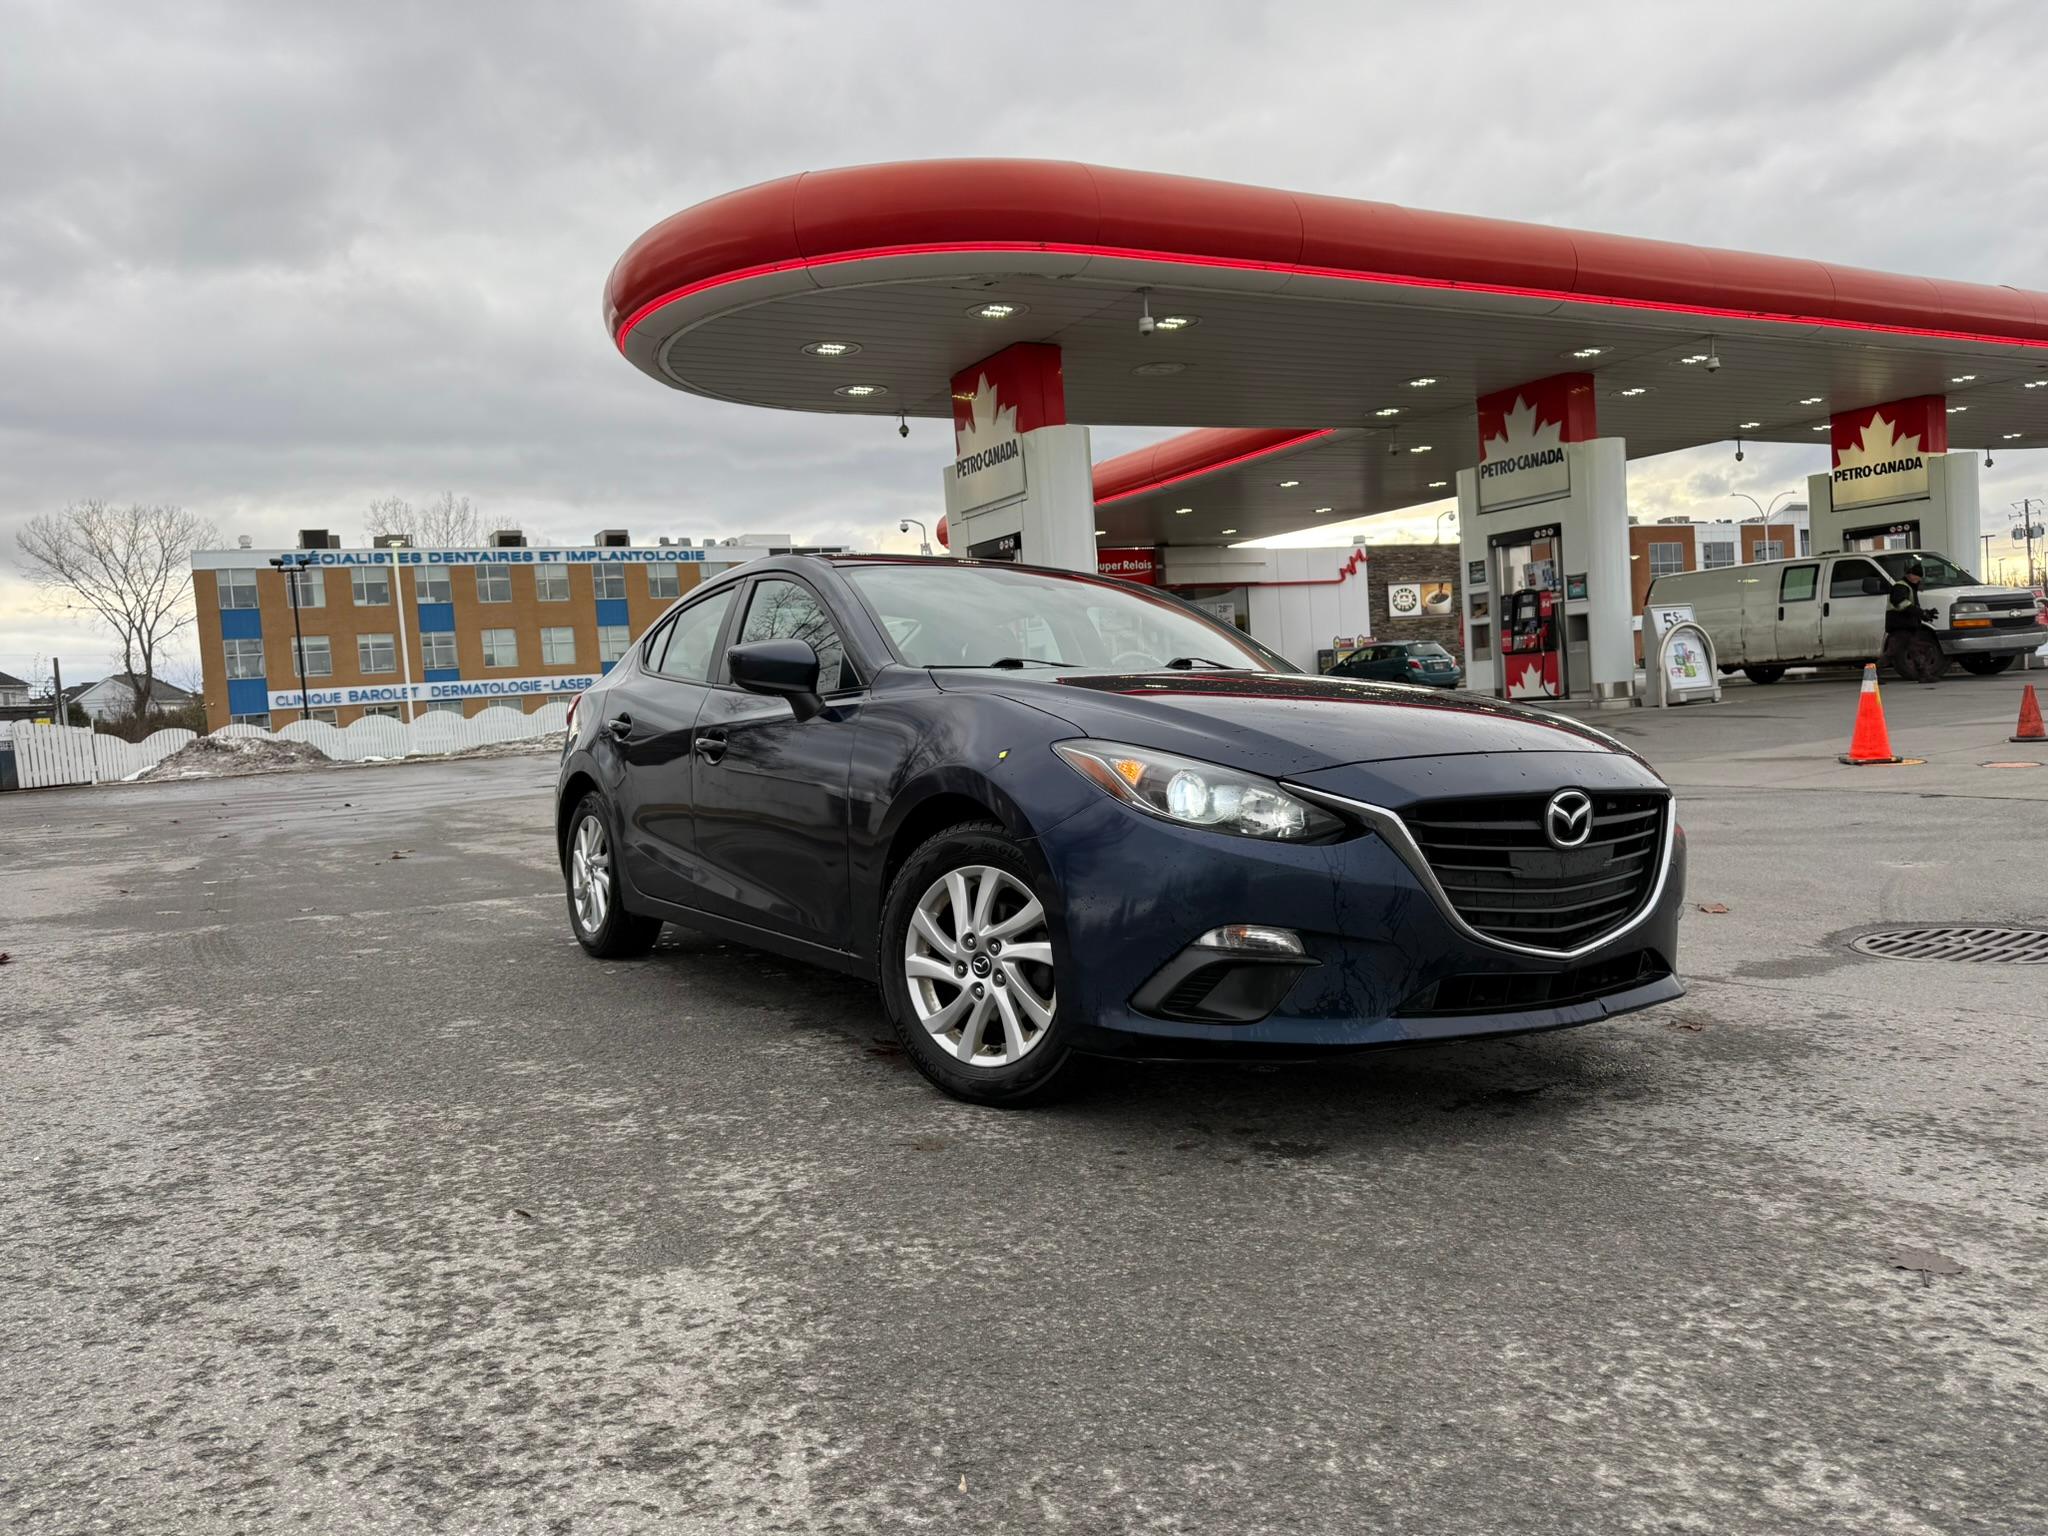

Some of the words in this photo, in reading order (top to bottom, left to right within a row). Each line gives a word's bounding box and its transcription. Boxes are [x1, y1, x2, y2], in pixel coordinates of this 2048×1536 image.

[281, 550, 423, 565] SPÉCIALISTES
[428, 551, 534, 563] DENTAIRES
[539, 551, 561, 562] ET
[566, 550, 706, 562] IMPLANTOLOGIE
[1098, 562, 1122, 573] uper
[1123, 559, 1153, 570] Relais
[275, 692, 342, 706] CLINIQUE
[348, 686, 420, 702] BAROLET
